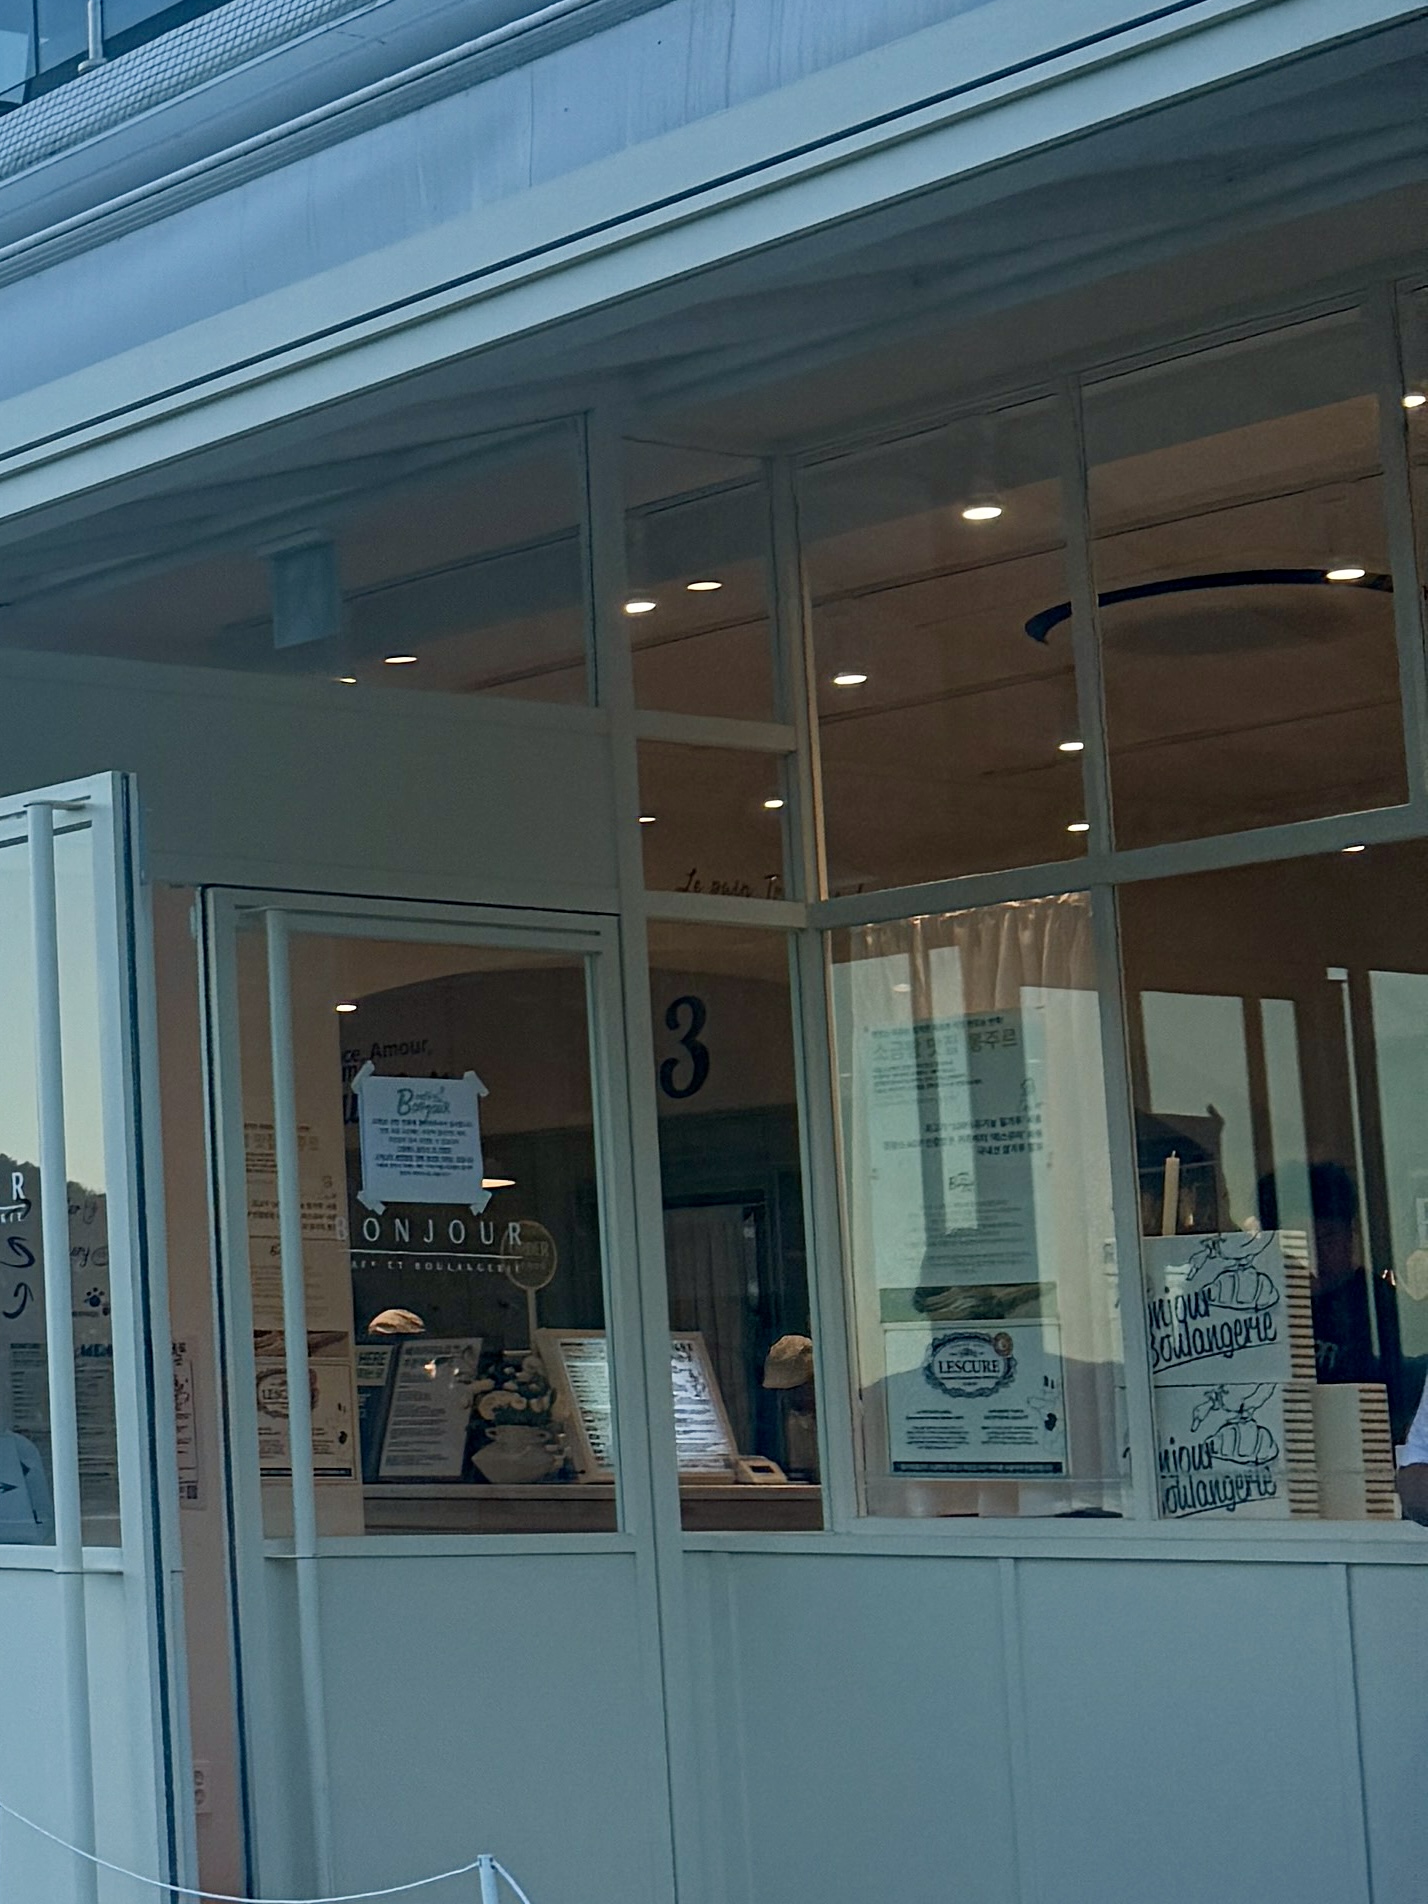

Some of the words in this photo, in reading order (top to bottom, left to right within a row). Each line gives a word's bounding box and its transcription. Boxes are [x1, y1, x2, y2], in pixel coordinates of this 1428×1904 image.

[659, 994, 711, 1100] 3
[335, 1216, 523, 1246] BONJOUR
[1148, 1285, 1215, 1341] njour
[938, 1359, 999, 1374] LESCURE
[1159, 1437, 1217, 1484] njour
[1162, 1466, 1278, 1516] oulangerie
